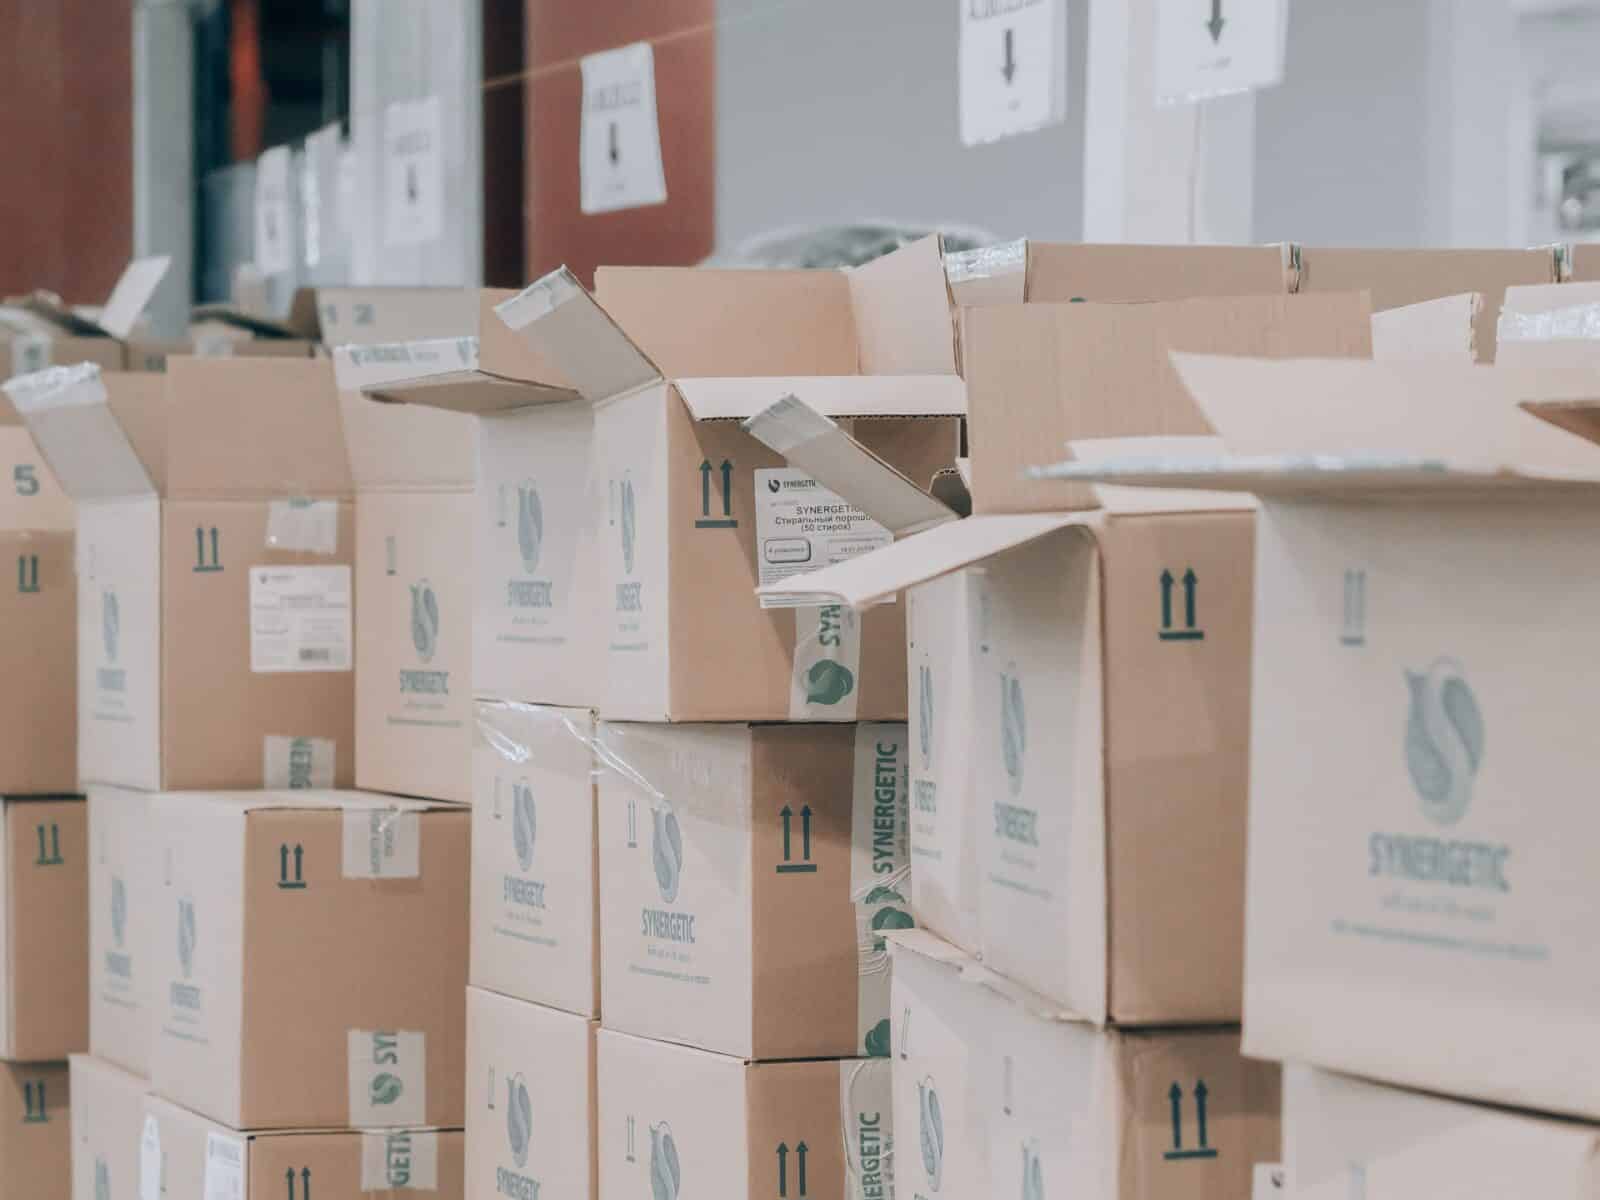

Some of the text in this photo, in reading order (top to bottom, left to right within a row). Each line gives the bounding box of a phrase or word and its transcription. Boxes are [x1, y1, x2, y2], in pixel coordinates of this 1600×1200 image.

[13, 465, 40, 494] 5
[873, 743, 897, 874] SYNERGETIC
[641, 907, 696, 945] SYNERGETIC
